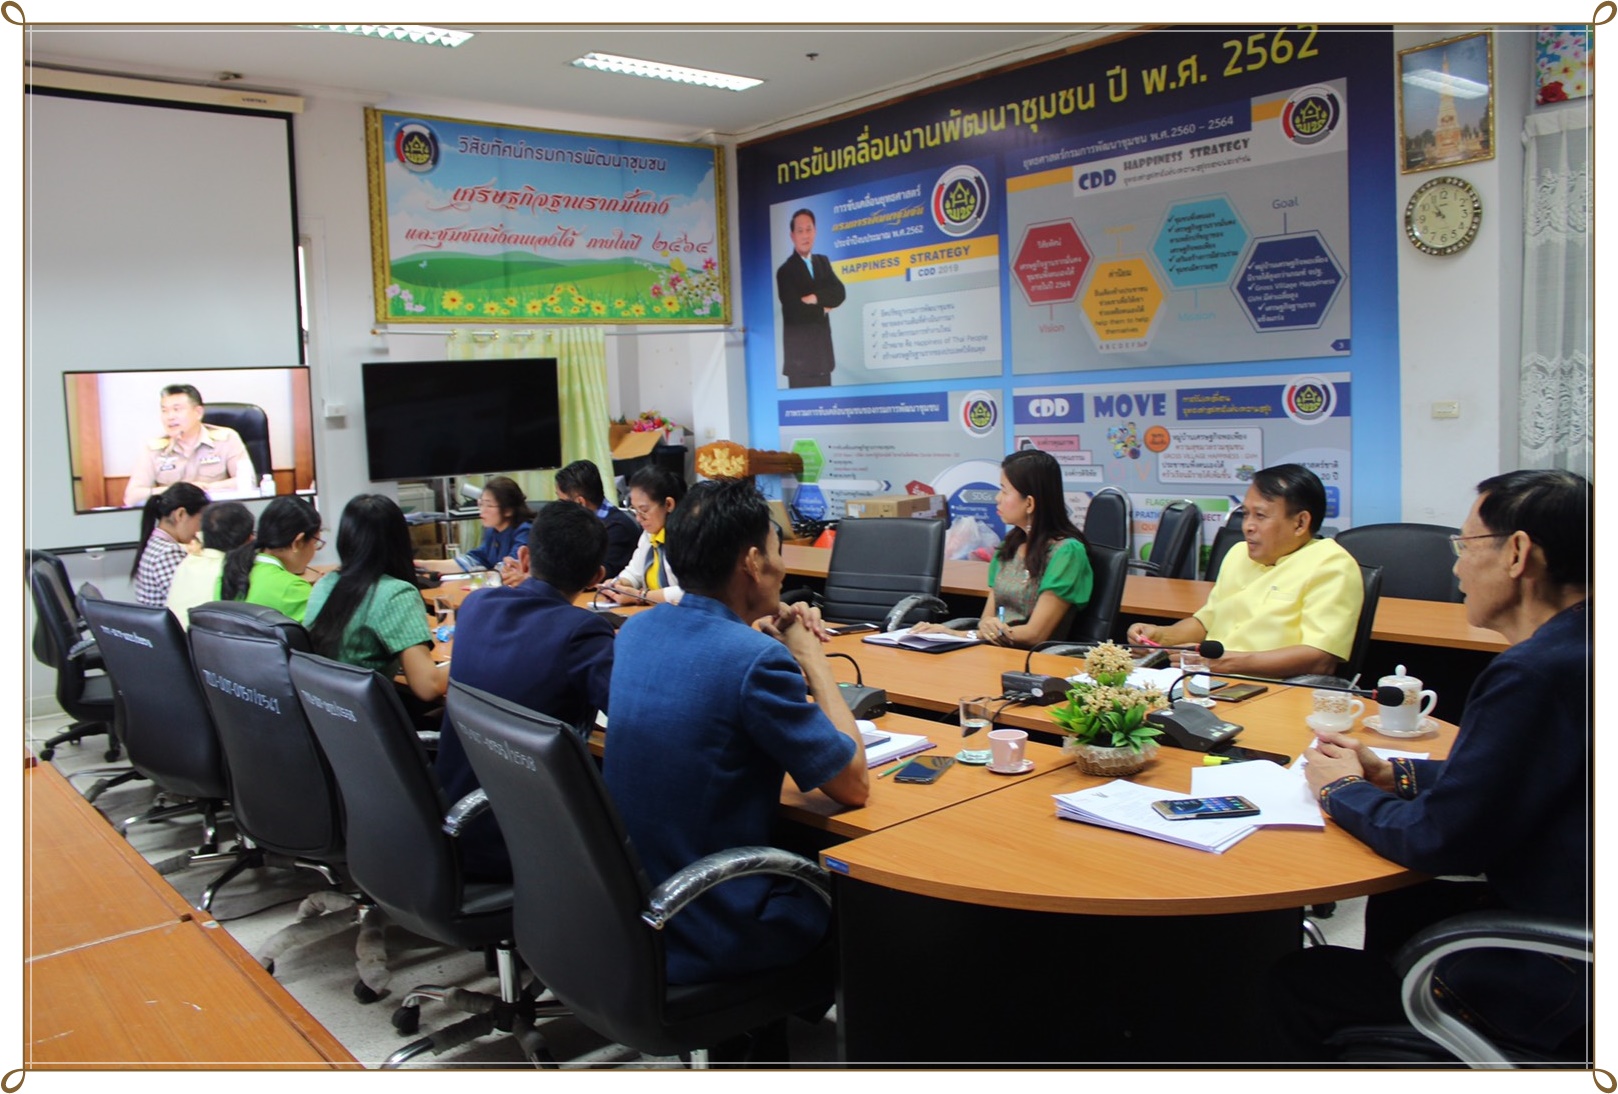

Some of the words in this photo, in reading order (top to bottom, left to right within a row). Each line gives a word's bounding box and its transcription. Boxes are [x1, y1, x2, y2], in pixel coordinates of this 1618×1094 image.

[777, 85, 1095, 184] การขับเคลื่อนงานพัฒนาชุมชน
[1108, 67, 1128, 103] ปี
[1142, 55, 1207, 96] พ.ศ.
[1222, 25, 1320, 78] 2562
[1207, 115, 1234, 130] 2564
[458, 136, 669, 176] วิสัยทัศน์กรมการพัฒนาชุมชน
[1123, 151, 1184, 172] HAPPINESS
[1189, 138, 1251, 160] STRATEGY
[1078, 169, 1117, 190] CDD
[1272, 196, 1299, 210] Goal
[842, 257, 901, 275] HAPPINESS
[910, 245, 971, 264] STRATEGY
[917, 267, 936, 277] CDD
[938, 263, 959, 274] 2019
[1028, 397, 1070, 417] CDD
[1093, 393, 1167, 418] MOVE
